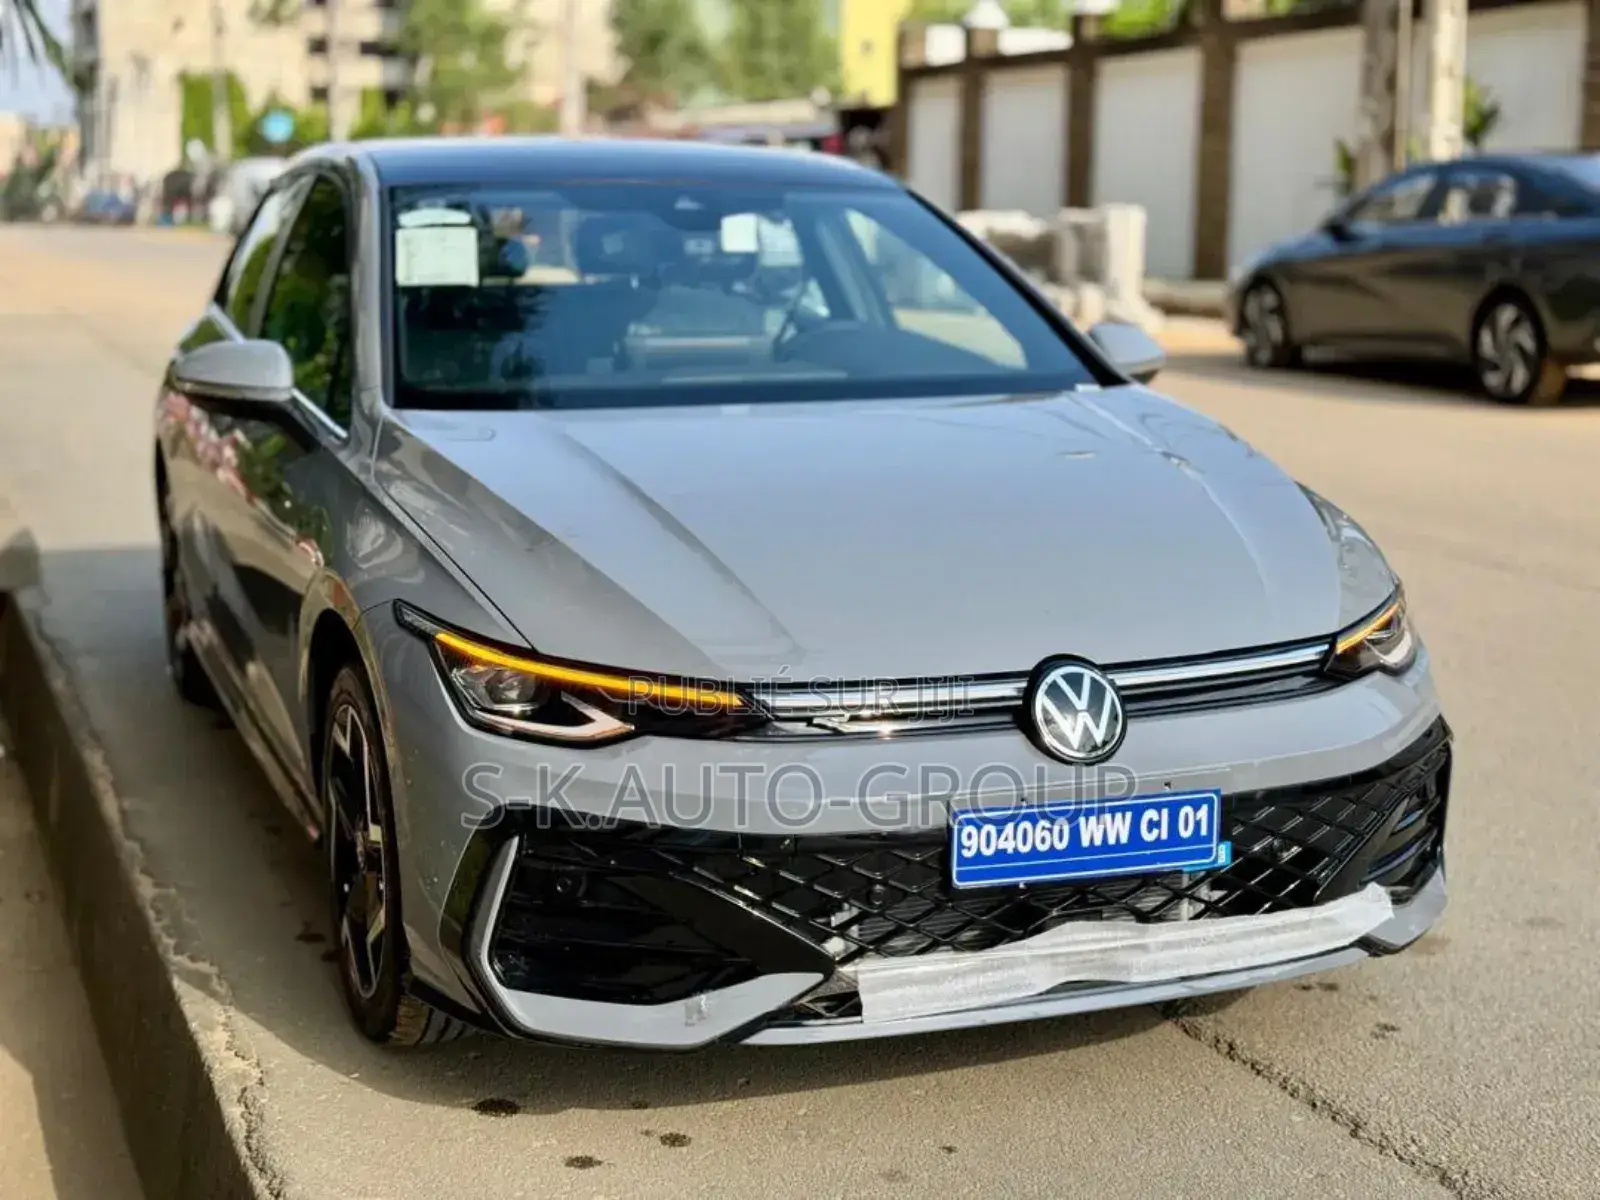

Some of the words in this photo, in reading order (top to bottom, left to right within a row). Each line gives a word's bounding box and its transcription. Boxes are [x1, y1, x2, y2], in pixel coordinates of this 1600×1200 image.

[960, 817, 1070, 858] 904060
[1079, 810, 1133, 848] WW
[1140, 805, 1169, 842] CI
[1178, 803, 1209, 838] 01
